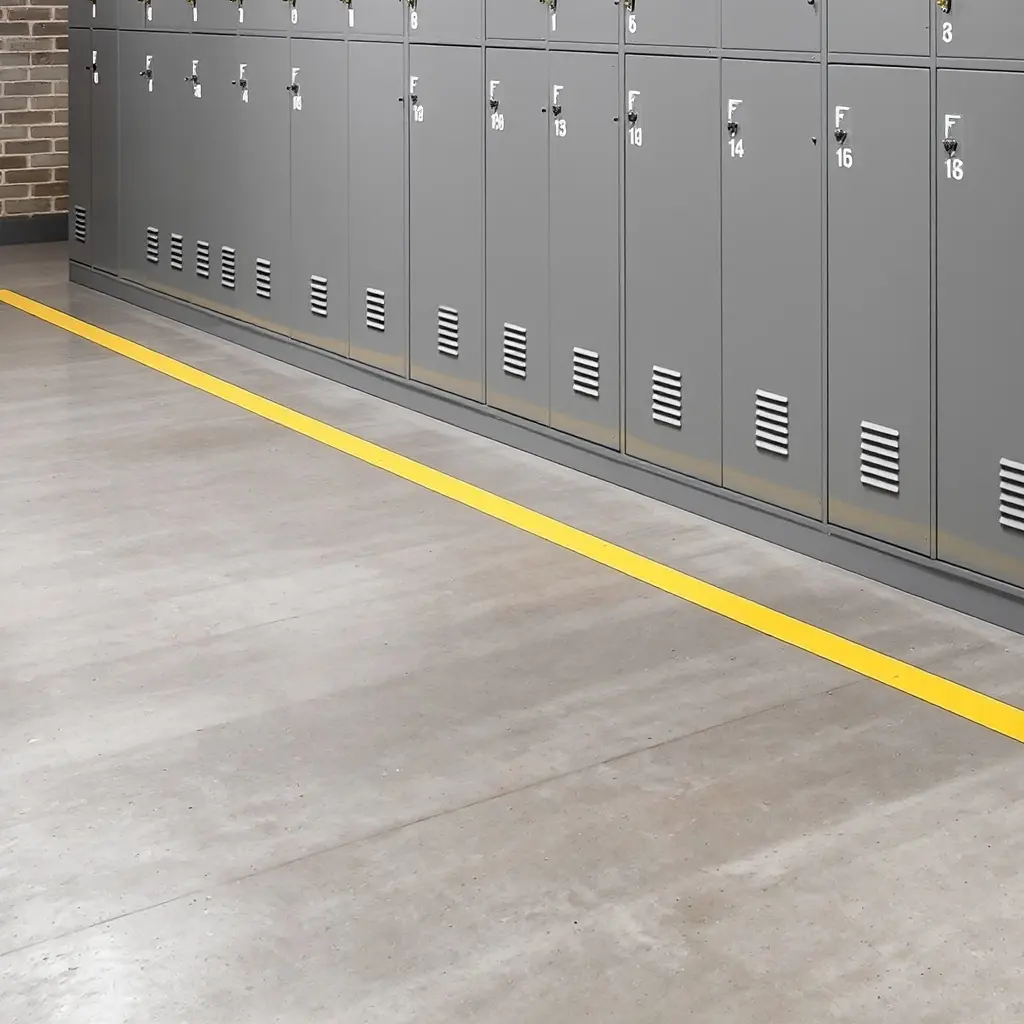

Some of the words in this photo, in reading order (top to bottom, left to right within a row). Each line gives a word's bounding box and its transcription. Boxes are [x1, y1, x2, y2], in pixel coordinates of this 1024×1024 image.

[410, 75, 419, 94] F
[490, 80, 500, 97] F
[553, 84, 564, 105] F
[628, 90, 641, 111] F
[728, 98, 743, 122] F
[835, 105, 851, 128] F
[944, 114, 962, 139] F
[728, 138, 745, 158] 14
[836, 148, 853, 168] 16
[944, 158, 964, 181] 18
